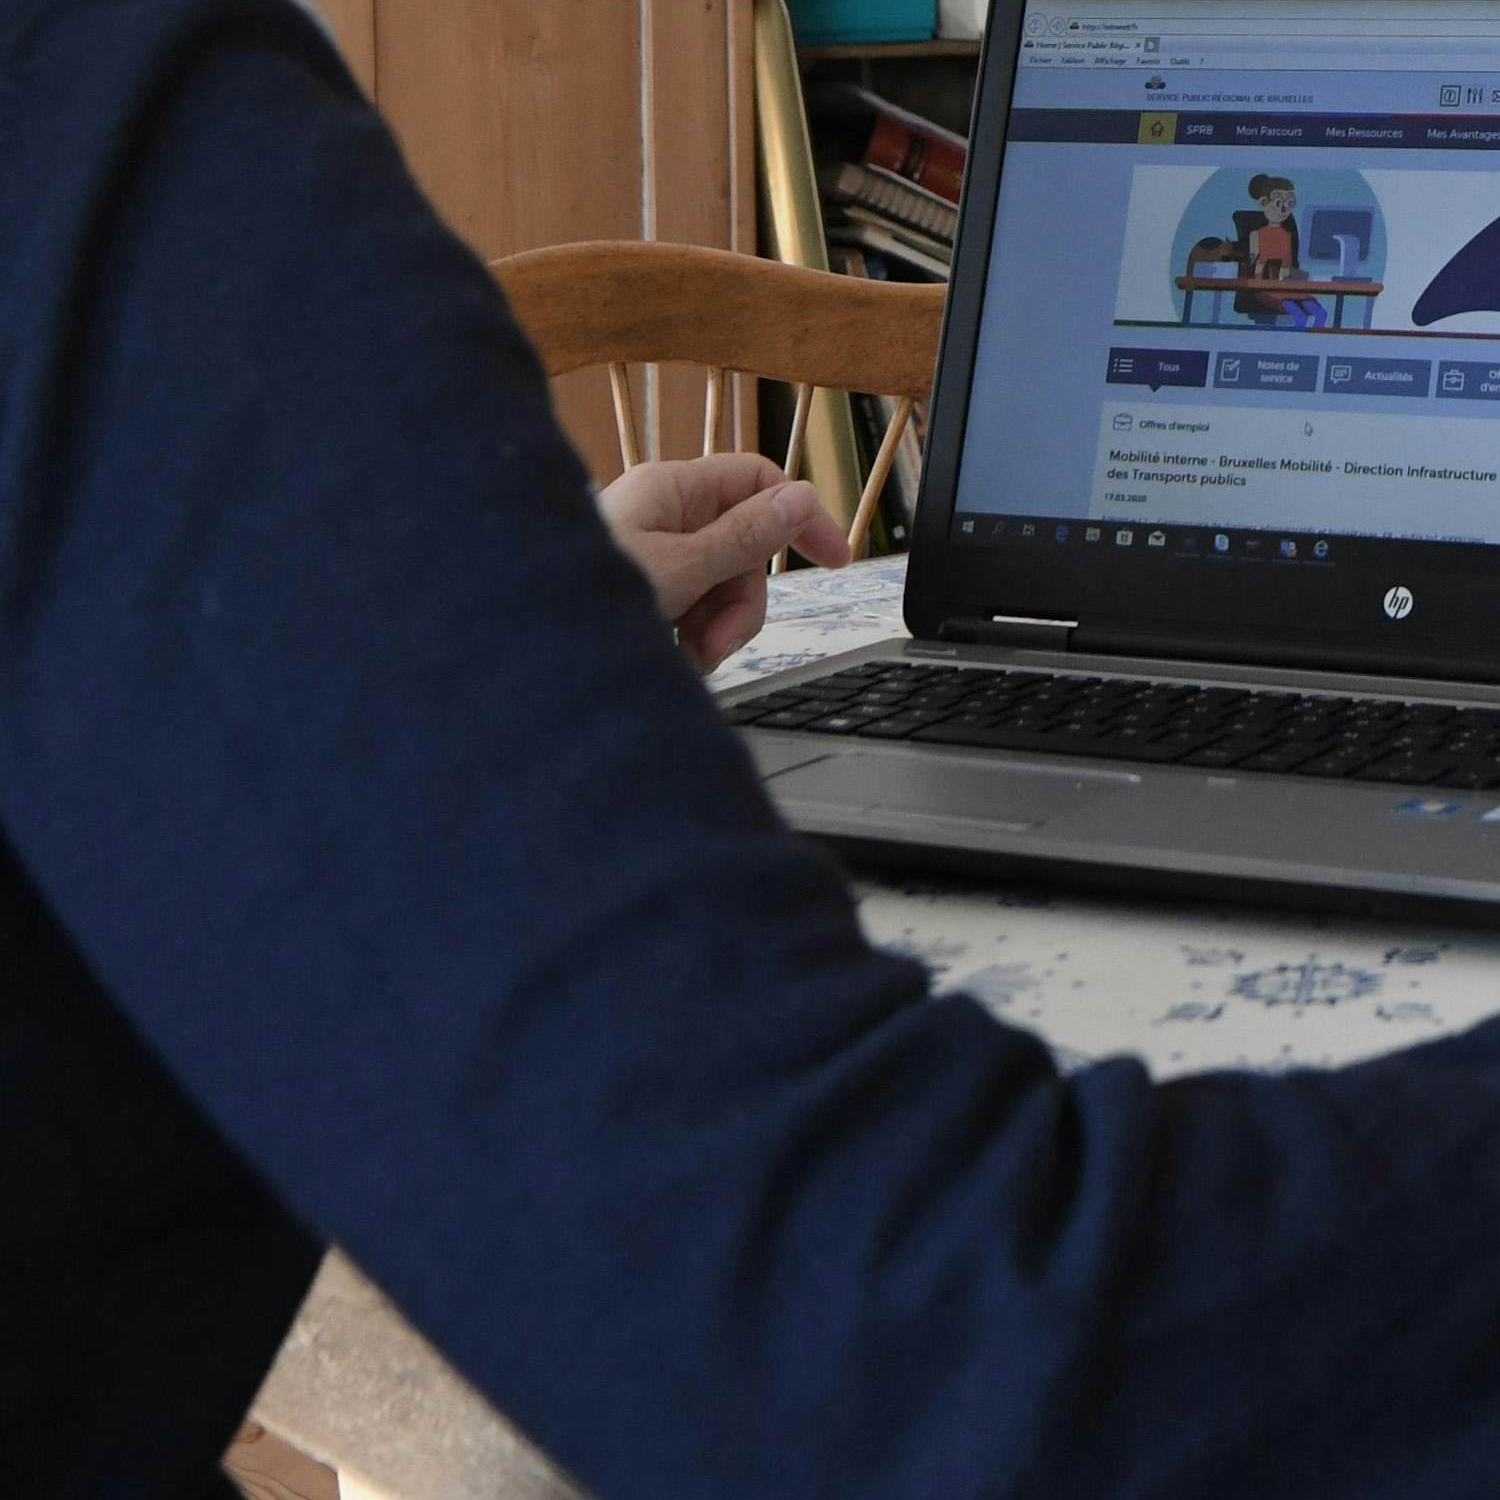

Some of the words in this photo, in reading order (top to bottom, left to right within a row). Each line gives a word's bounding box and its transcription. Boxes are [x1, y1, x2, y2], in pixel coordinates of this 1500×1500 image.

[1186, 124, 1215, 135] SPRB
[1236, 125, 1258, 136] Mon
[1260, 125, 1303, 137] Parcours
[1325, 127, 1346, 138] Mes
[1348, 127, 1404, 139] Ressources
[1427, 128, 1448, 139] Mes
[1158, 361, 1181, 372] Tous
[1257, 359, 1284, 371] Notes
[1285, 361, 1300, 372] de
[1259, 373, 1294, 383] service
[1363, 370, 1414, 382] Actualités
[1139, 419, 1167, 431] Offres
[1168, 420, 1210, 433] d'emploi
[1109, 450, 1160, 464] Mobilité
[1162, 453, 1208, 467] interne
[1219, 455, 1277, 470] Bruxelles
[1279, 457, 1333, 473] Mobilité
[1344, 461, 1403, 477] Direction
[1406, 465, 1498, 482] Infrastructure
[1107, 467, 1129, 480] des
[1132, 469, 1198, 485] Transports
[1199, 471, 1247, 487] publics
[1386, 586, 1411, 619] hp
